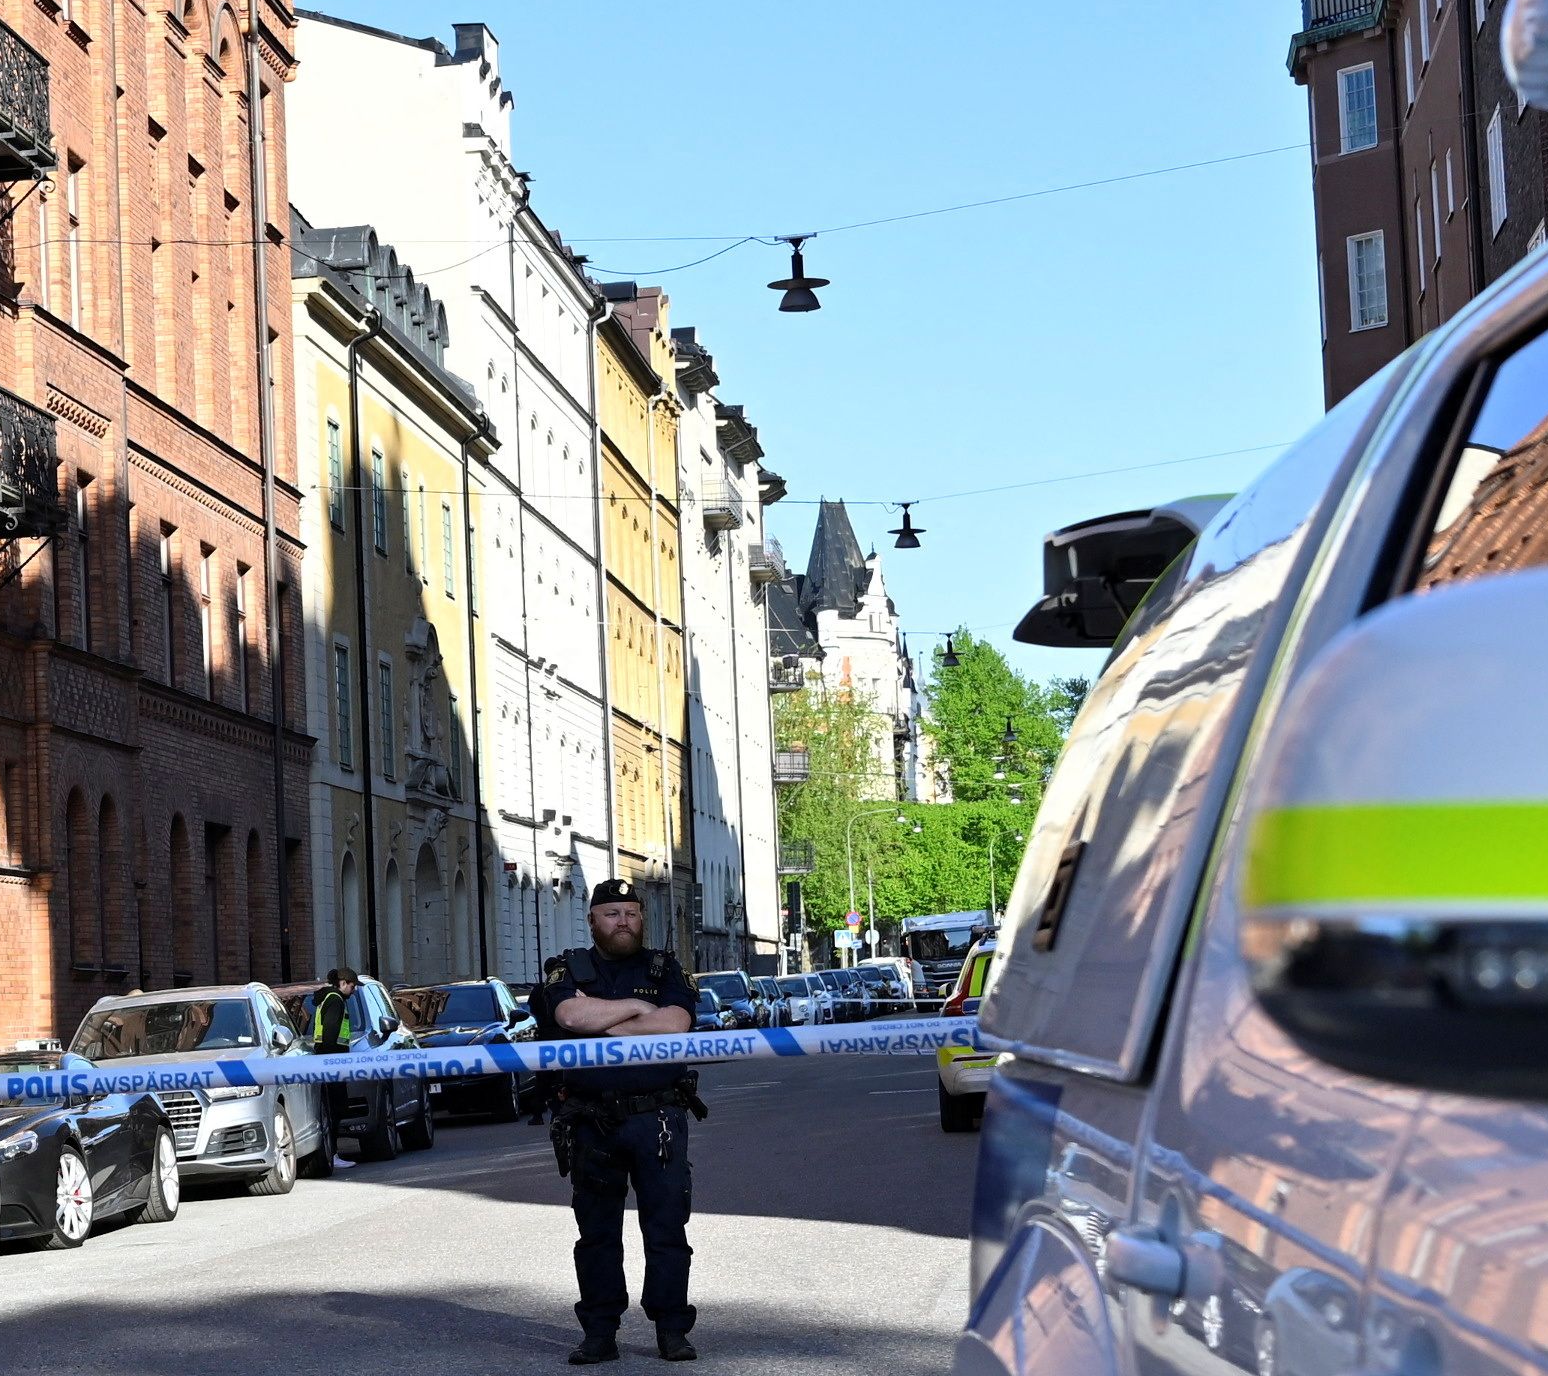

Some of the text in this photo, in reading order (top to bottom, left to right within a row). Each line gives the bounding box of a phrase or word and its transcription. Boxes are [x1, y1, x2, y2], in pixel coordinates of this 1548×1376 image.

[395, 1052, 427, 1060] POLICE
[538, 1036, 755, 1069] POLIS AVSPÄRRAT
[323, 1058, 353, 1066] CROSS
[355, 1056, 374, 1064] NOT
[7, 1070, 214, 1099] POLIS AVSPÄRRAT
